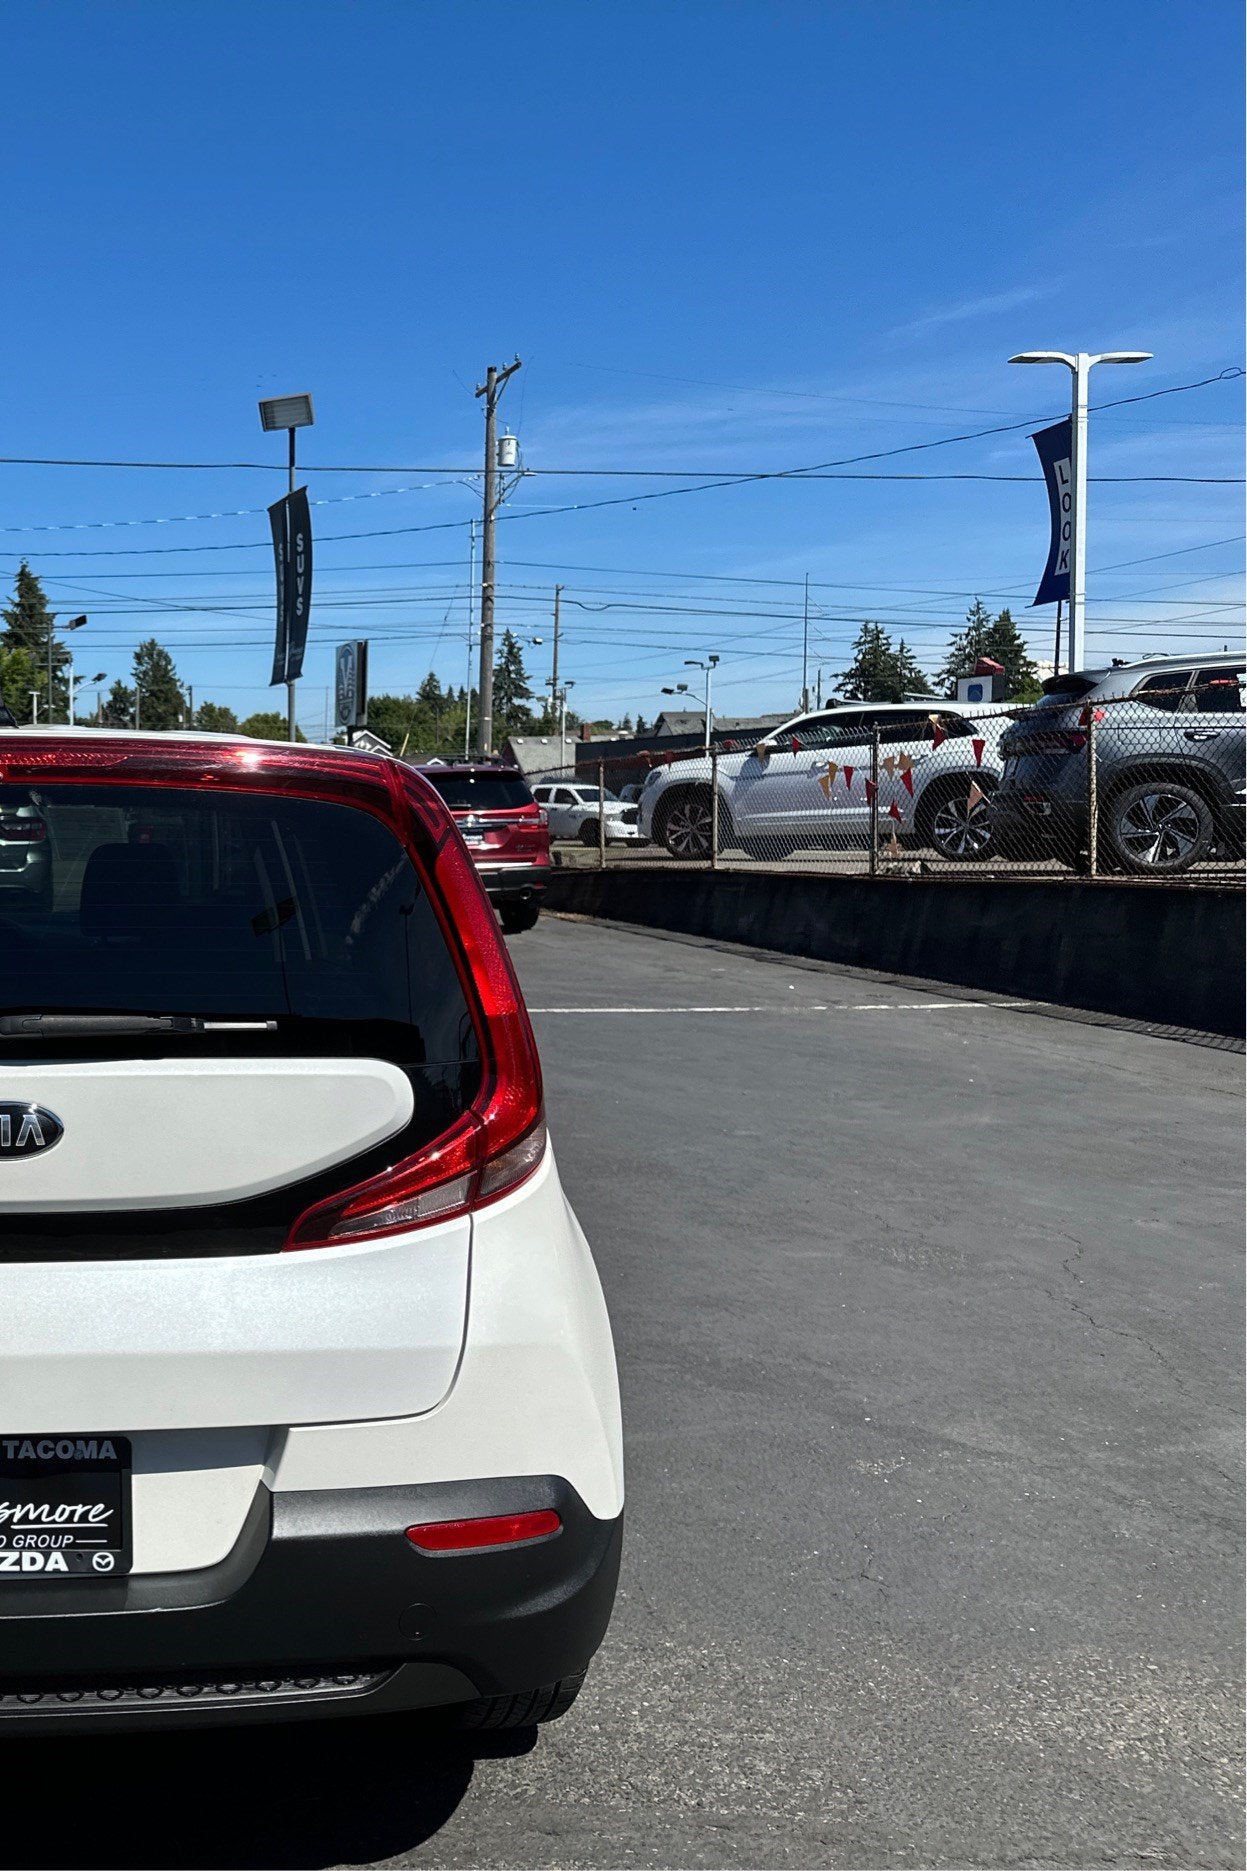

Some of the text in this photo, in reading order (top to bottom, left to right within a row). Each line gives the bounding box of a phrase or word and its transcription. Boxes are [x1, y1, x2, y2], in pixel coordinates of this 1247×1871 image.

[1059, 464, 1071, 571] LOOK
[296, 533, 305, 617] SUVS
[2, 1440, 117, 1460] TACOMA
[12, 1534, 74, 1549] GROUP
